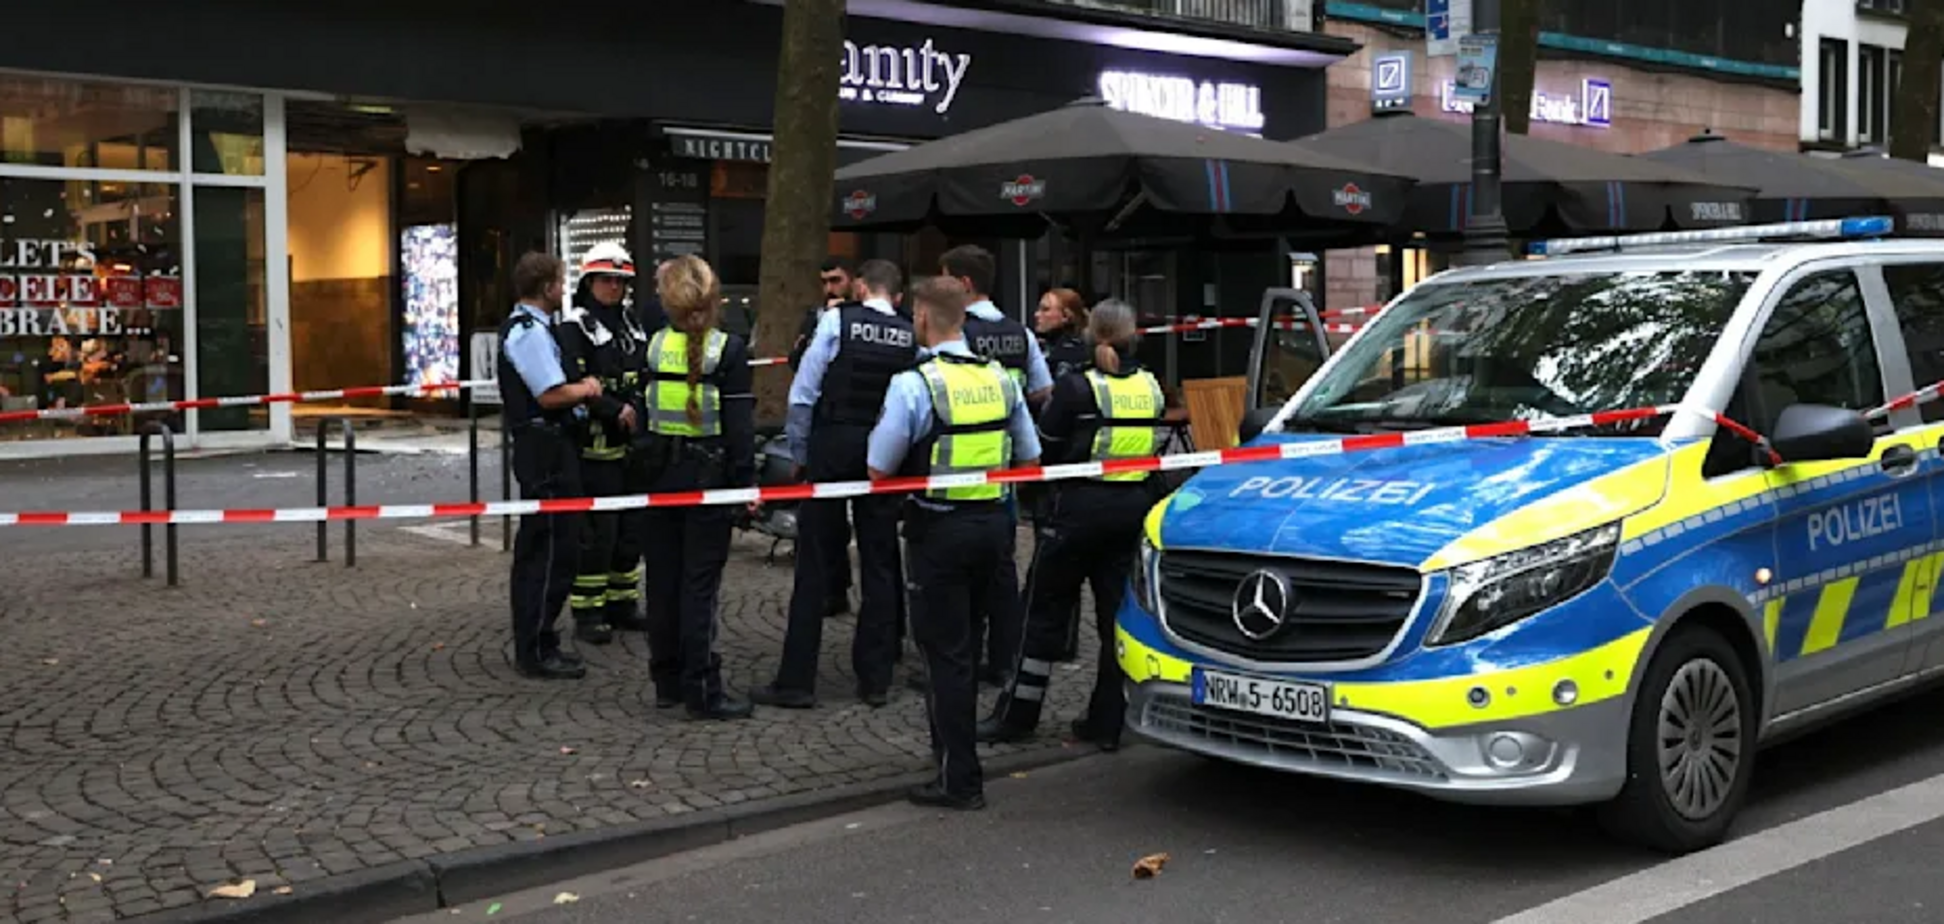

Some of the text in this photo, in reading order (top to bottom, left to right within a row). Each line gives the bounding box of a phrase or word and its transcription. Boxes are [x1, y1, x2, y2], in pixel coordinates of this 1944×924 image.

[840, 38, 970, 113] anity
[685, 139, 772, 162] NIGHTCL
[850, 323, 914, 348] POLIZEI
[1229, 475, 1436, 506] POLIZEI
[1807, 492, 1904, 551] POLIZEI
[1204, 674, 1323, 718] NRW 5-6508
